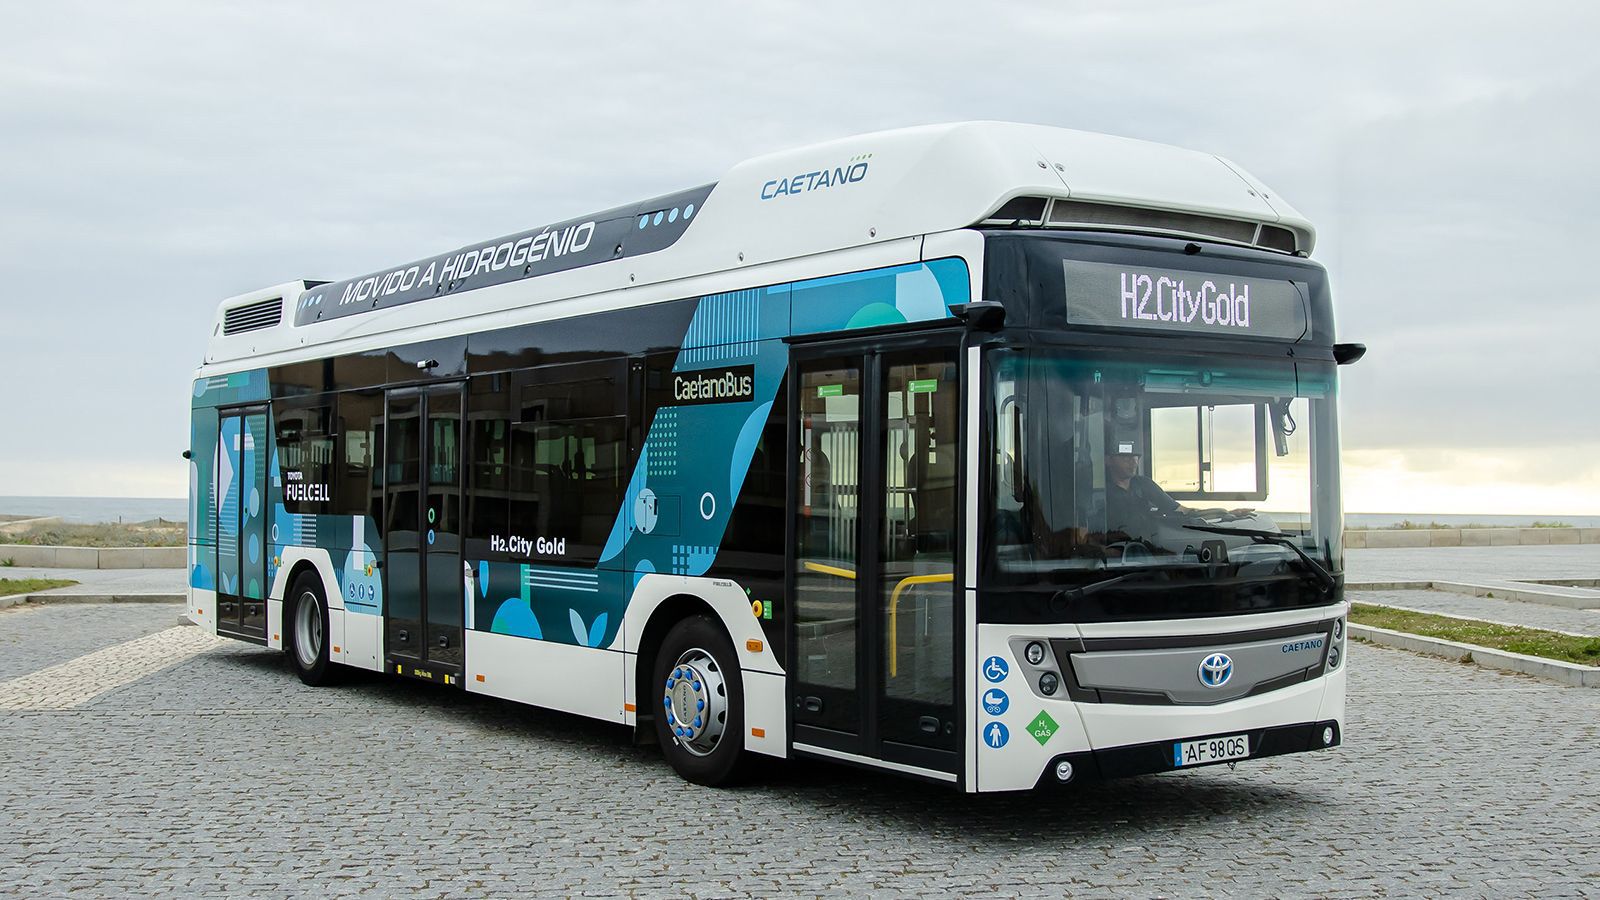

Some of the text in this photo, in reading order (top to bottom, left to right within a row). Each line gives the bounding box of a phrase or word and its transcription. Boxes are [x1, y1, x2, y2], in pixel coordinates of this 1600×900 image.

[761, 162, 869, 200] CAETANO
[339, 221, 596, 306] MOVIDO A HIDROGÉNIO
[674, 371, 752, 401] CaetanoBus
[286, 483, 330, 502] FUELCELL
[491, 534, 566, 557] H2.City Gold
[1281, 639, 1323, 653] CAETANO
[1034, 729, 1051, 737] GAS
